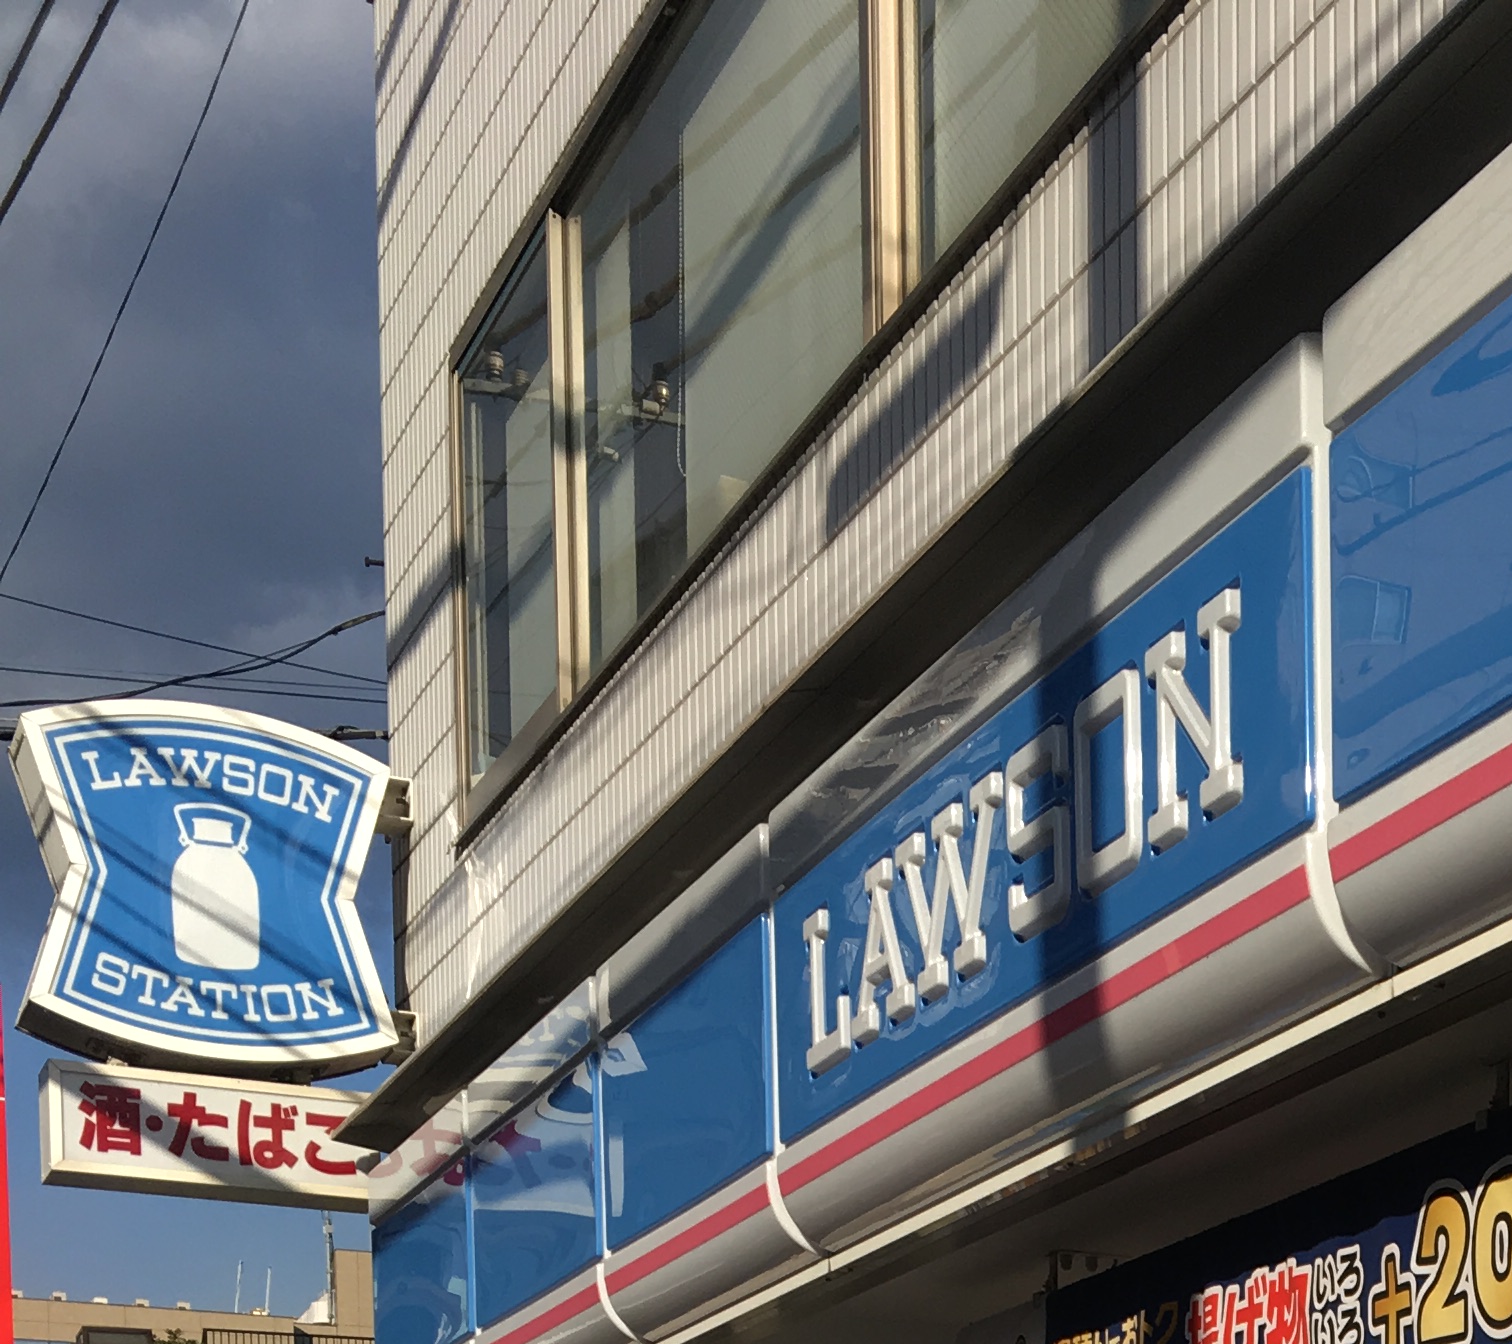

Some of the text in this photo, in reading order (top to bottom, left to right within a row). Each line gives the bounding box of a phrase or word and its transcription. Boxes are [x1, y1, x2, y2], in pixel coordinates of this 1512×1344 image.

[82, 746, 339, 823] LAWSON
[803, 582, 1243, 1077] LAWSON
[92, 951, 345, 1024] STATION
